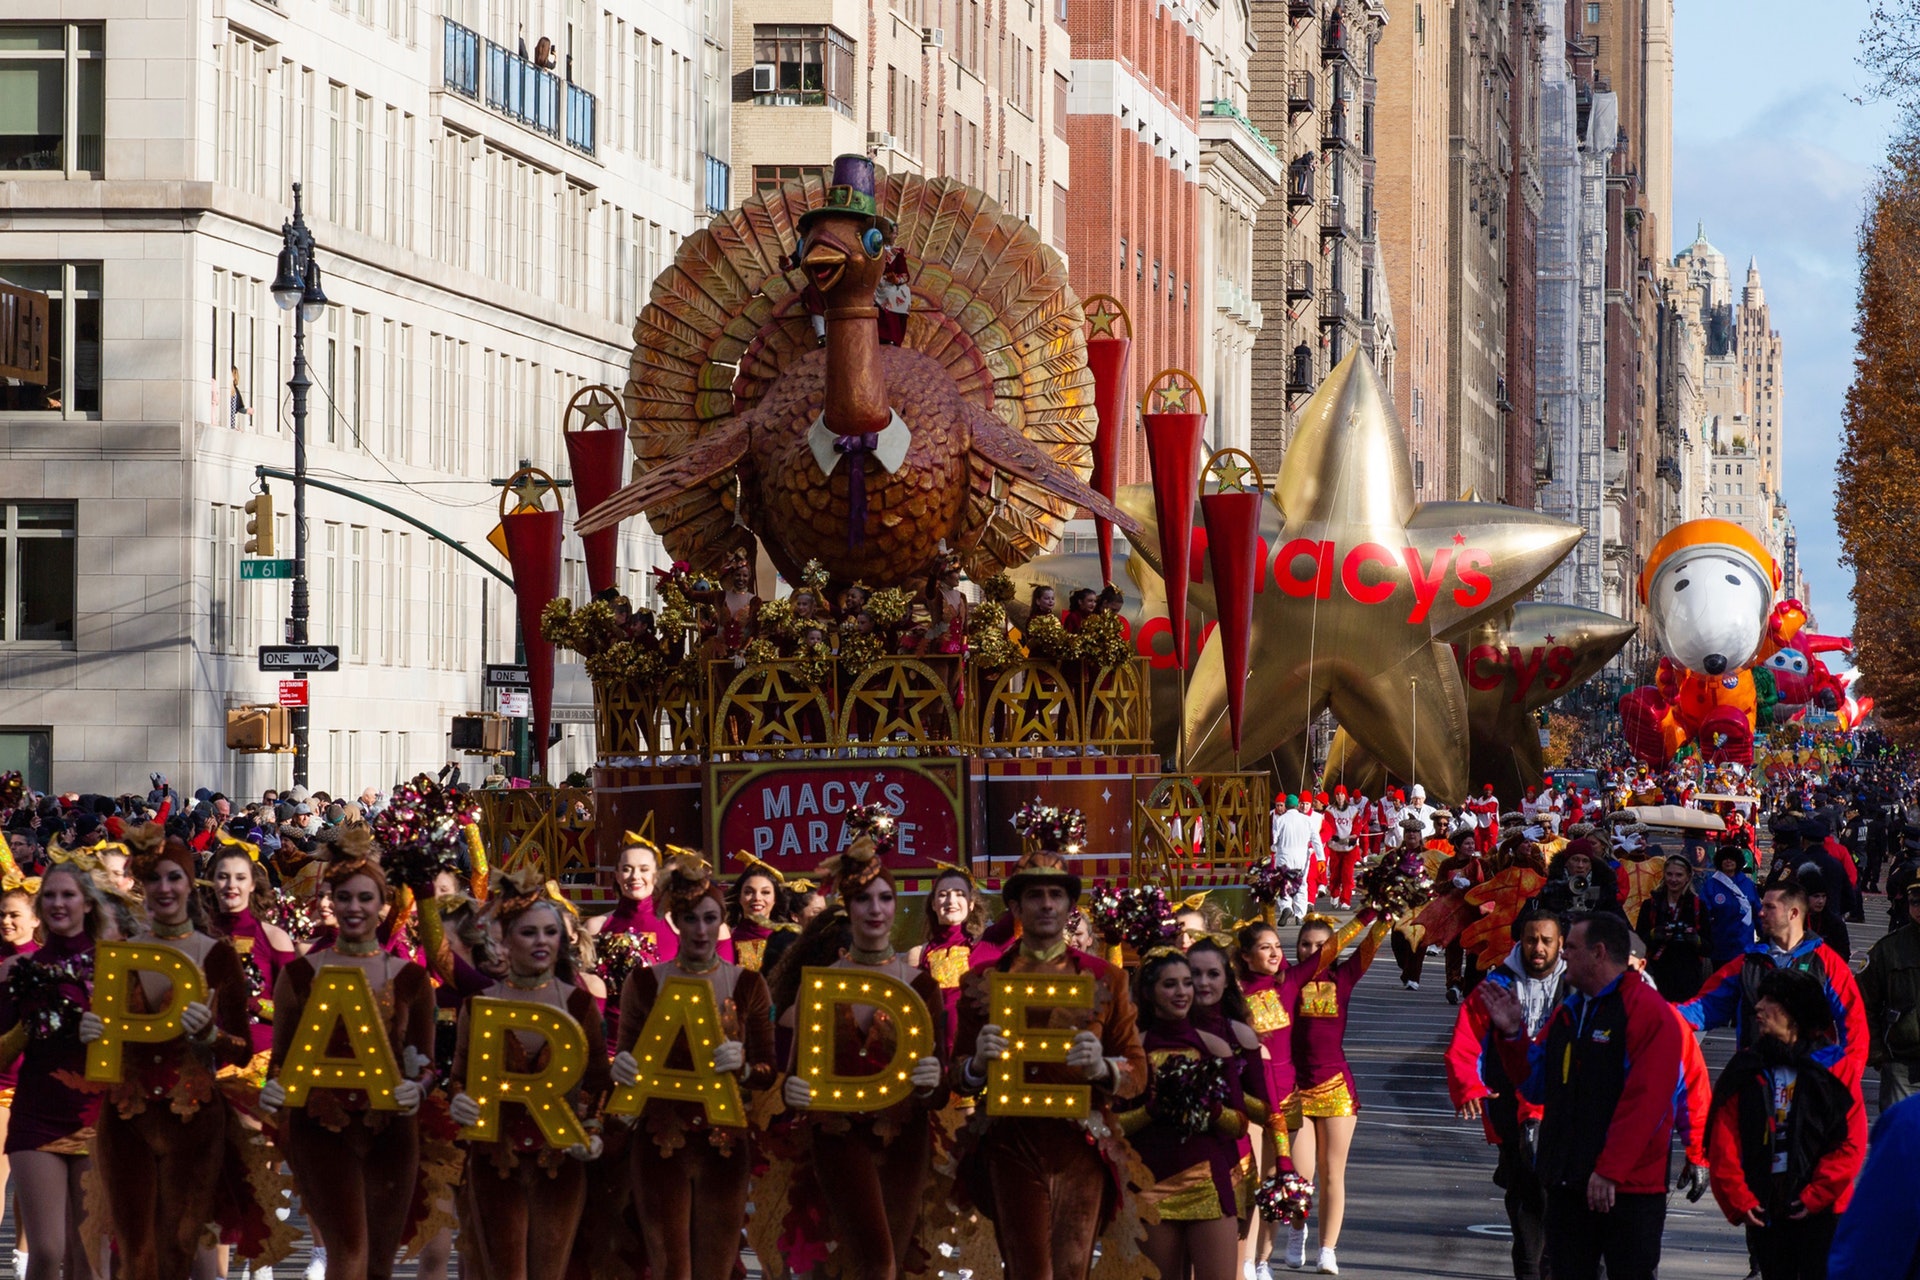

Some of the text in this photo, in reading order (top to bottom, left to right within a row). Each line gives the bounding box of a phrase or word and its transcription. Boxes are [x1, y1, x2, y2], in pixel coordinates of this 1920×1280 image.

[242, 562, 254, 577] W
[262, 562, 276, 577] 61
[266, 653, 328, 664] ONE WAY
[496, 671, 516, 681] ONE
[753, 820, 917, 859] PARAE
